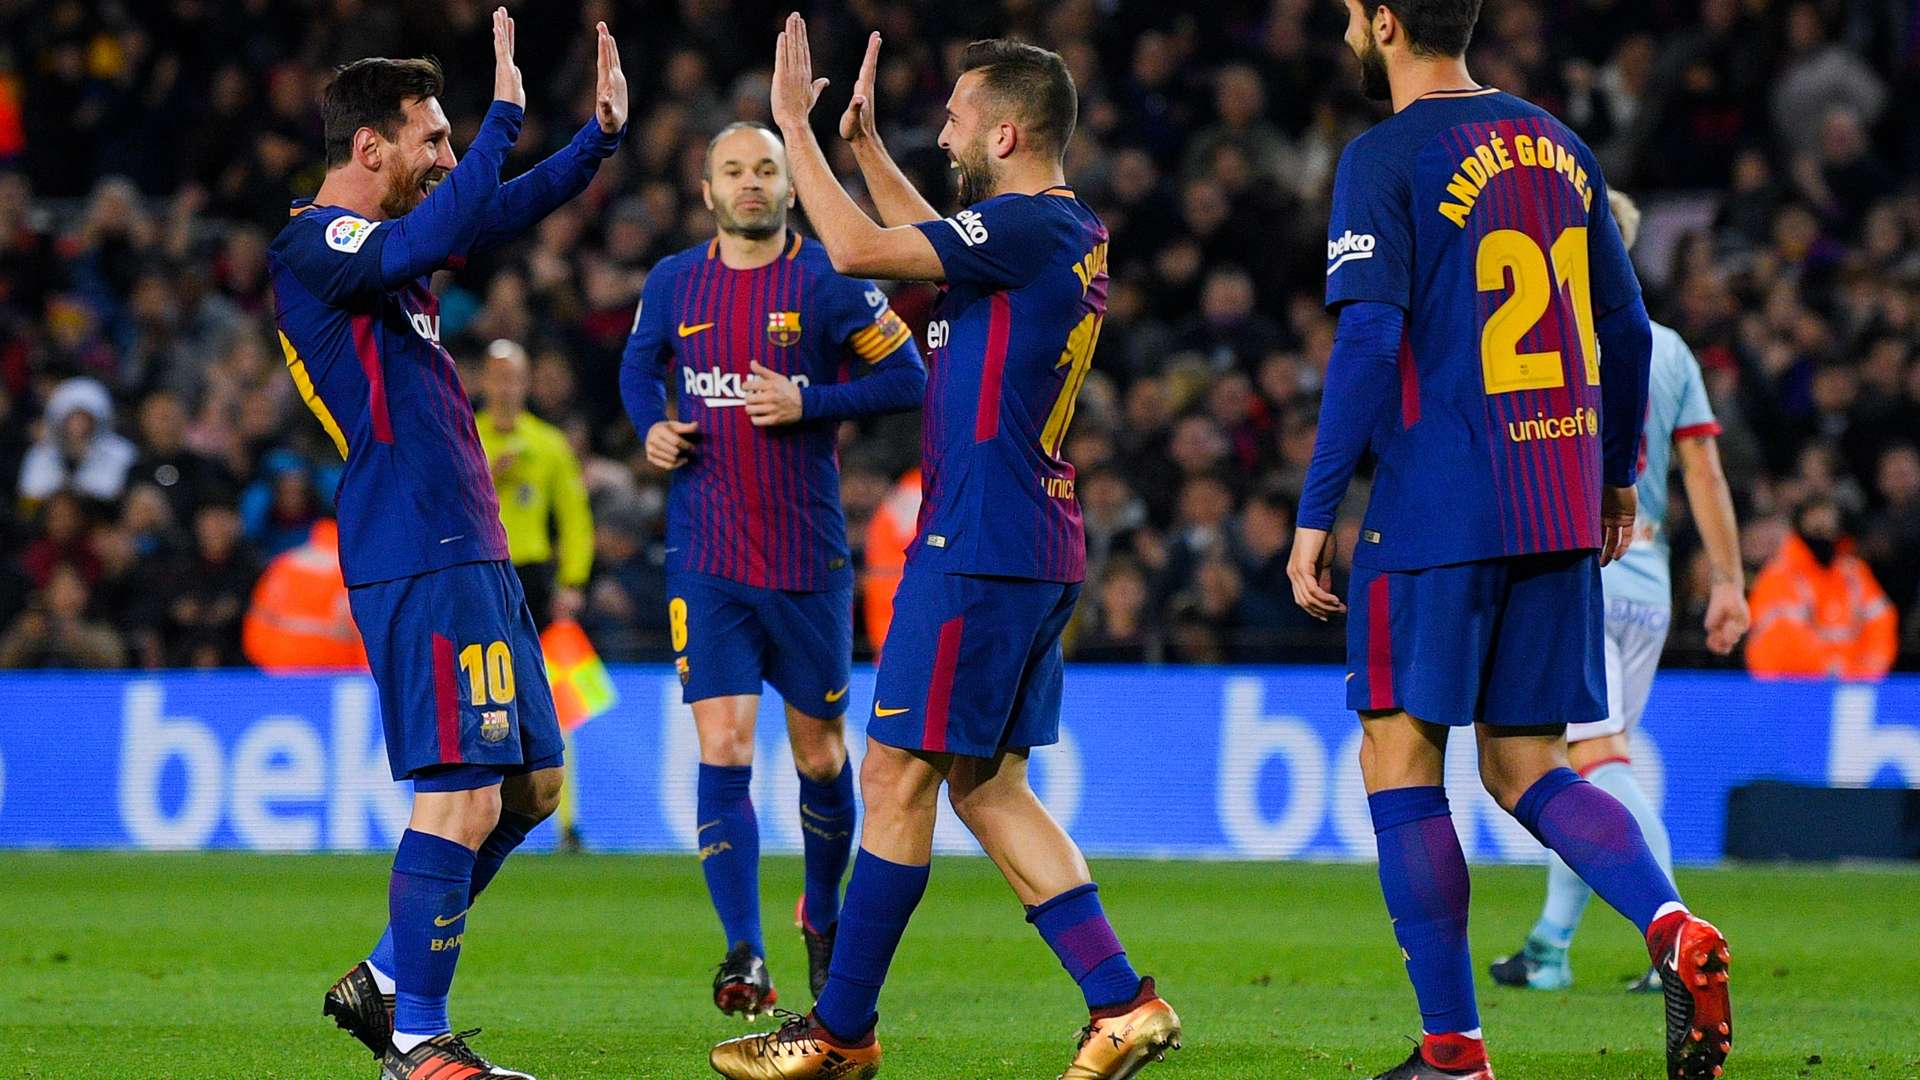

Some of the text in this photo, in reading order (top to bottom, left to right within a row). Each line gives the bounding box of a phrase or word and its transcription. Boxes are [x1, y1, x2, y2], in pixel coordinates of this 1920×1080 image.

[1438, 131, 1514, 228] ANDRÉ
[956, 210, 988, 244] eko
[1475, 226, 1600, 395] 21
[1508, 407, 1584, 442] unicef
[1041, 473, 1074, 499] unic
[459, 641, 516, 705] 10
[118, 680, 416, 850] bek
[431, 933, 465, 951] BAR
